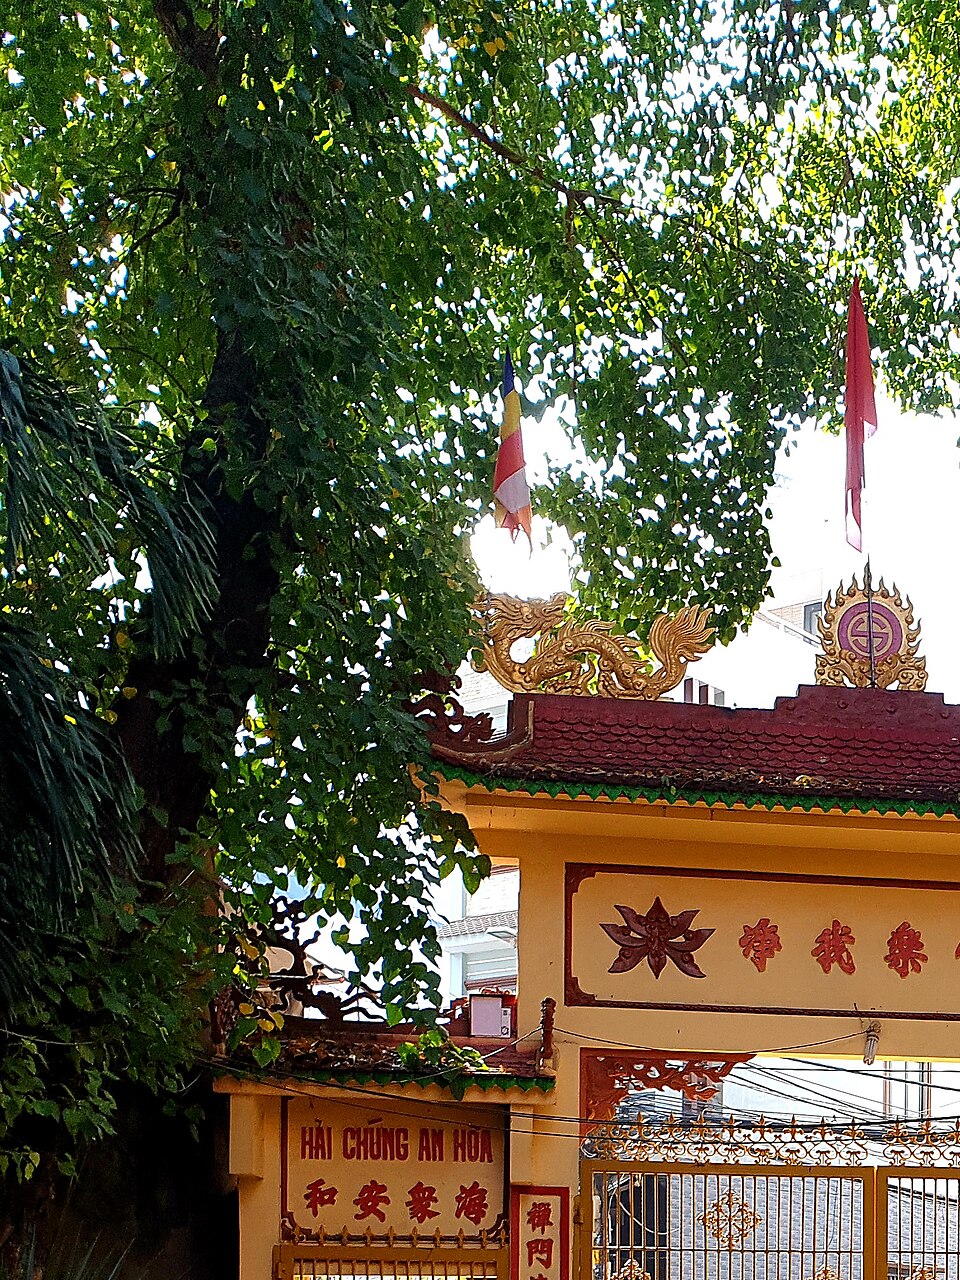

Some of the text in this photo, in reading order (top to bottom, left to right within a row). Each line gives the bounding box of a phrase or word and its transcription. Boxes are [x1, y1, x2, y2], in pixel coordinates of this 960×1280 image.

[300, 1117, 333, 1160] HẢI
[342, 1117, 409, 1161] CHÚNG
[418, 1128, 444, 1162] AN
